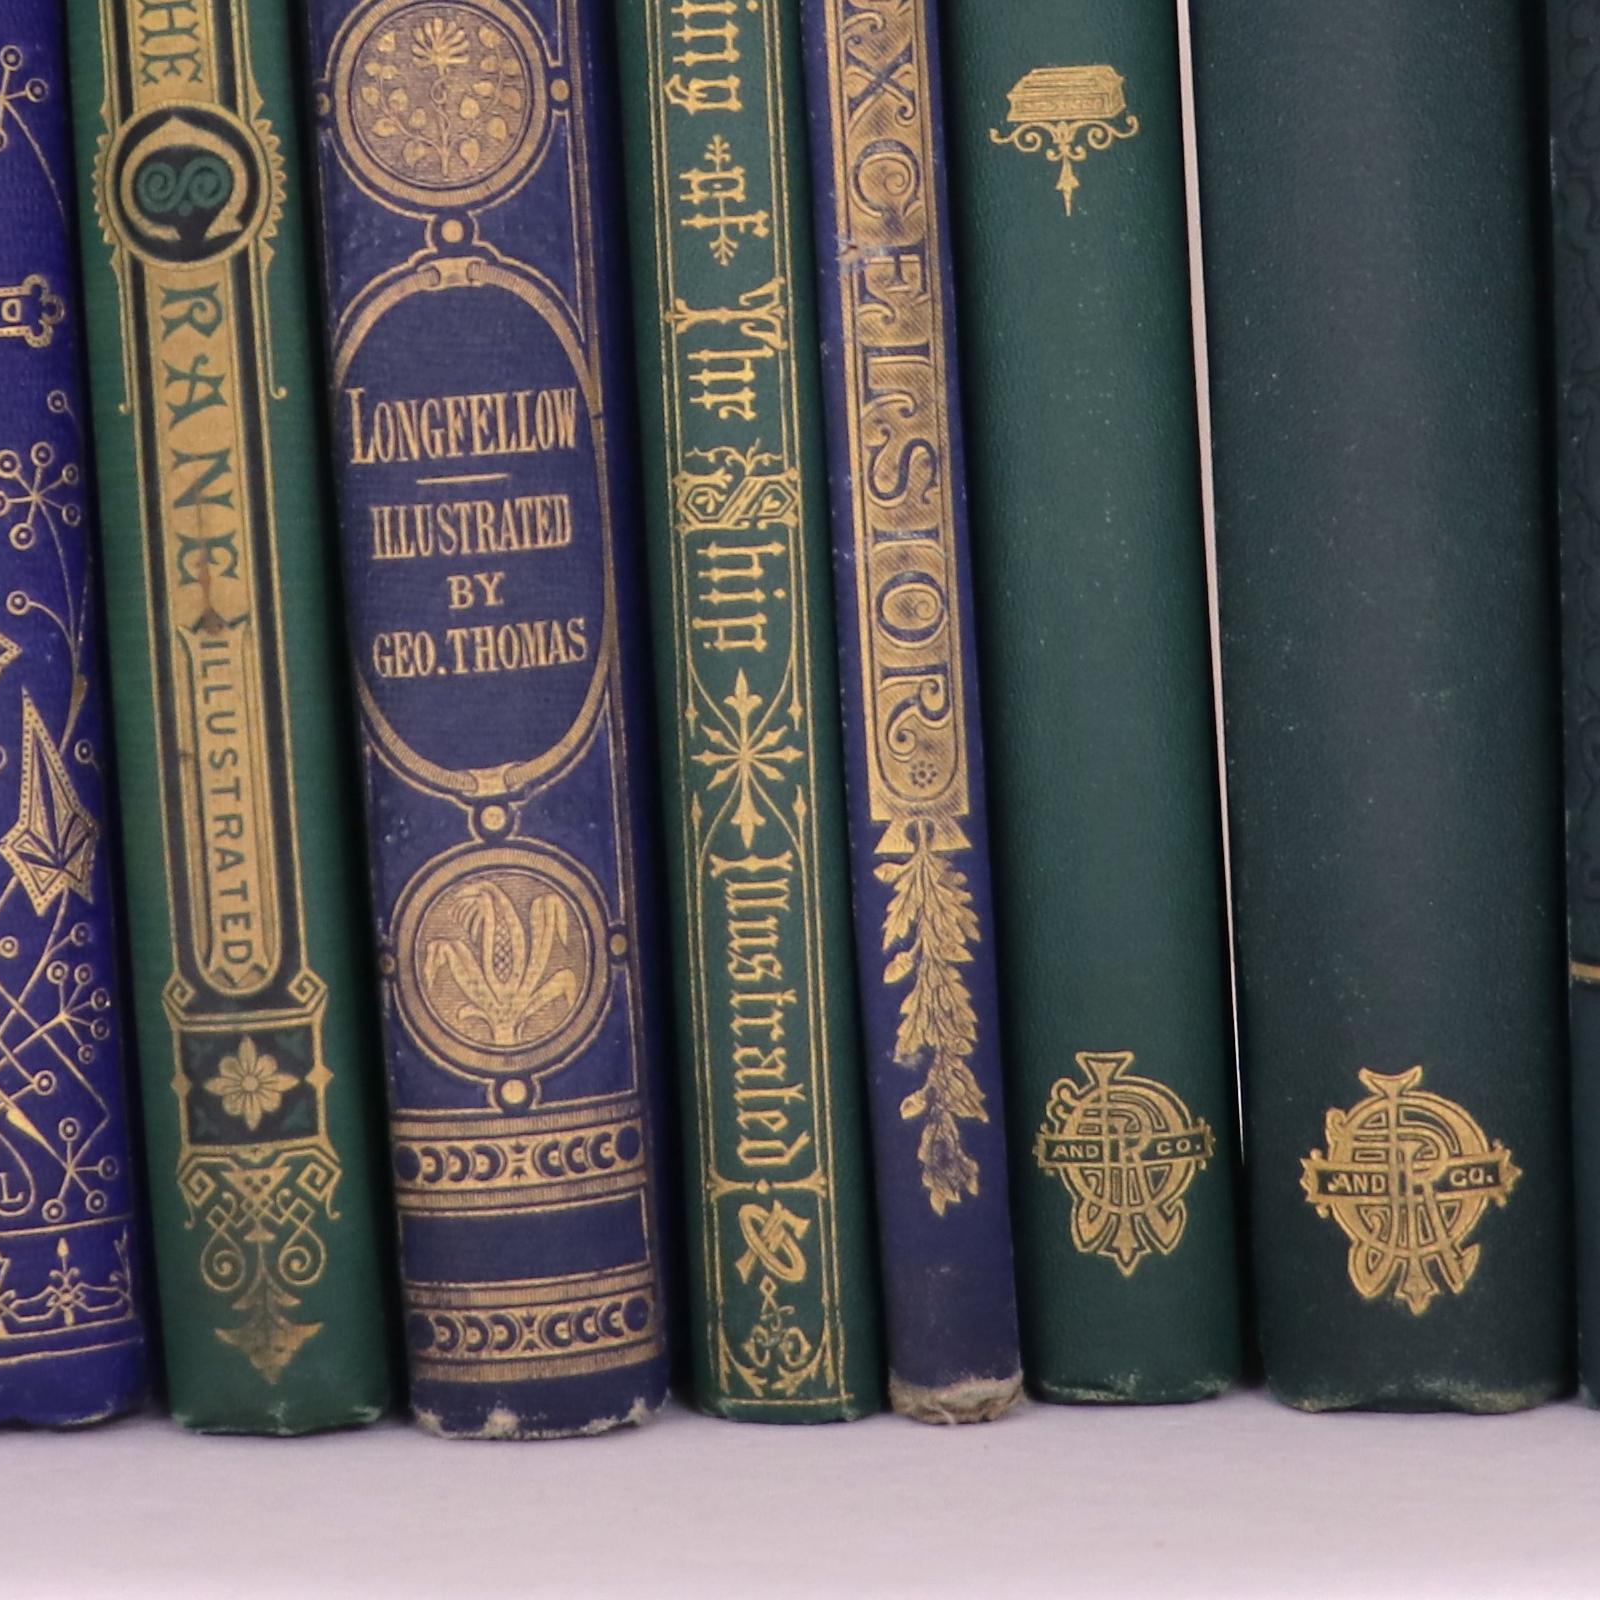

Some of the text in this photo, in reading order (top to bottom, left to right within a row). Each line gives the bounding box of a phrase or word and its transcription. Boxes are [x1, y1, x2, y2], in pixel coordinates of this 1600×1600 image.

[679, 166, 770, 238] of
[344, 386, 578, 466] LONGFELLOW
[369, 494, 573, 562] ILLUSTRATED
[672, 466, 801, 653] Ship
[448, 572, 505, 610] BY
[200, 640, 254, 966] ILLUSTRATED
[710, 850, 811, 1168] Illustrated
[1051, 1138, 1203, 1160] AND CO.
[1327, 1172, 1386, 1194] AND
